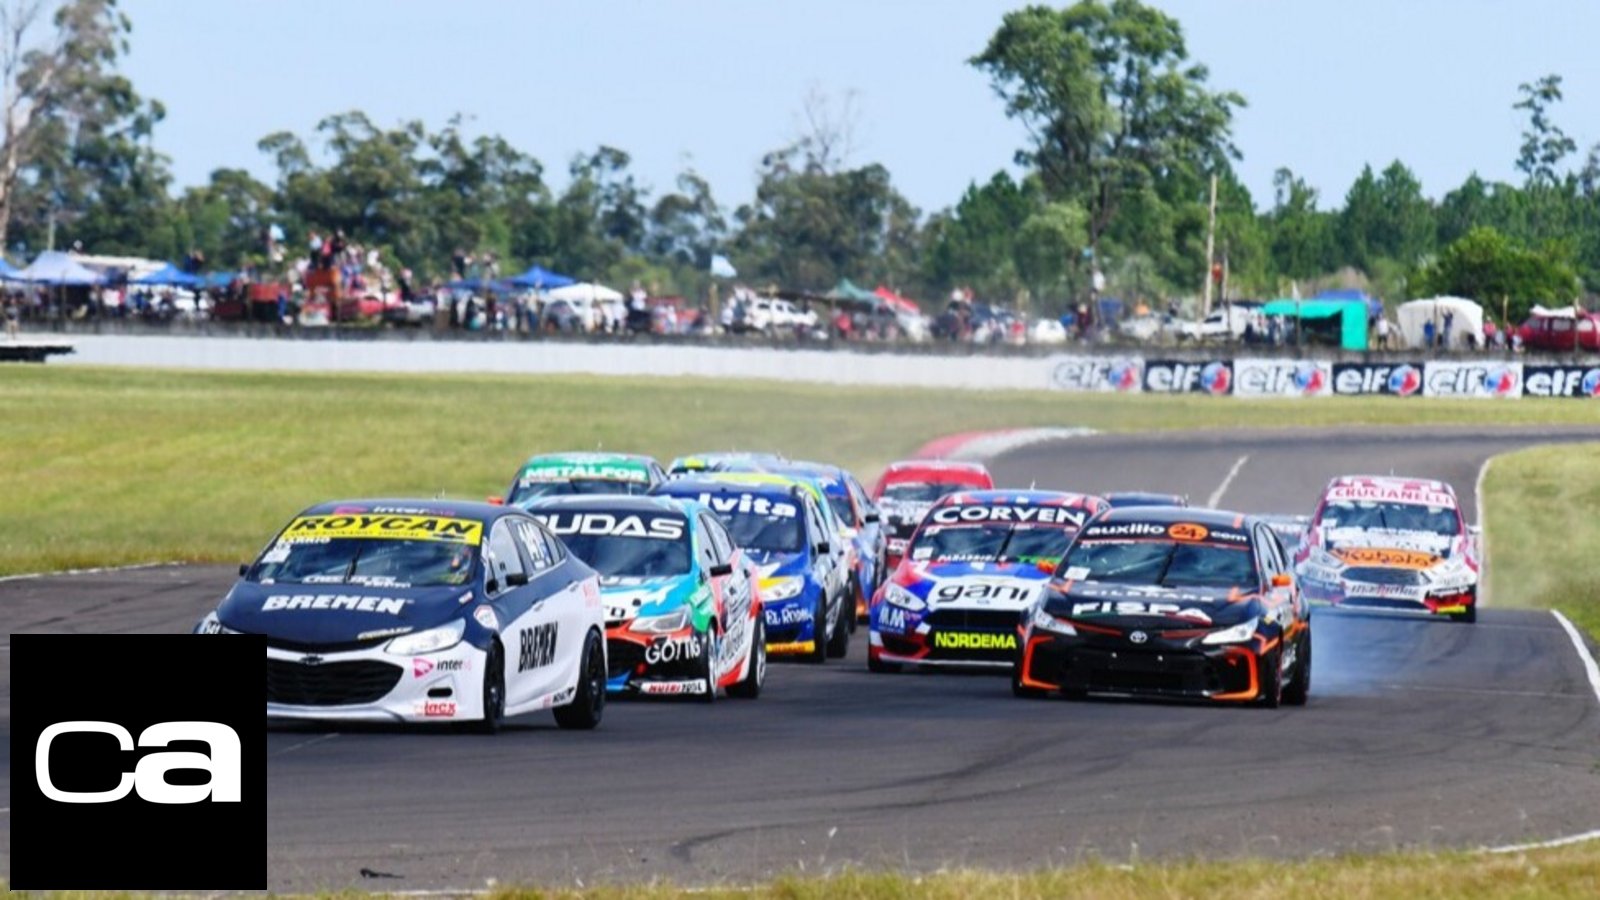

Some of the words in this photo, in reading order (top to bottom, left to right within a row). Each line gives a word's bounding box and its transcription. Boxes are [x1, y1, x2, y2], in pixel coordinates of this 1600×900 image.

[1146, 364, 1200, 391] elf
[1240, 366, 1298, 393] elf
[1336, 368, 1389, 393] elf
[1429, 368, 1487, 395] elf
[1526, 370, 1581, 396] elf
[525, 465, 647, 481] METALFOR
[1335, 487, 1450, 504] CRUCIANELLI
[292, 516, 477, 534] ROYCAN
[933, 506, 1085, 525] CORVEN
[936, 584, 1031, 603] gani
[261, 595, 406, 615] BREMEN
[517, 621, 558, 673] BREMEN
[935, 631, 1016, 649] NORDEMA
